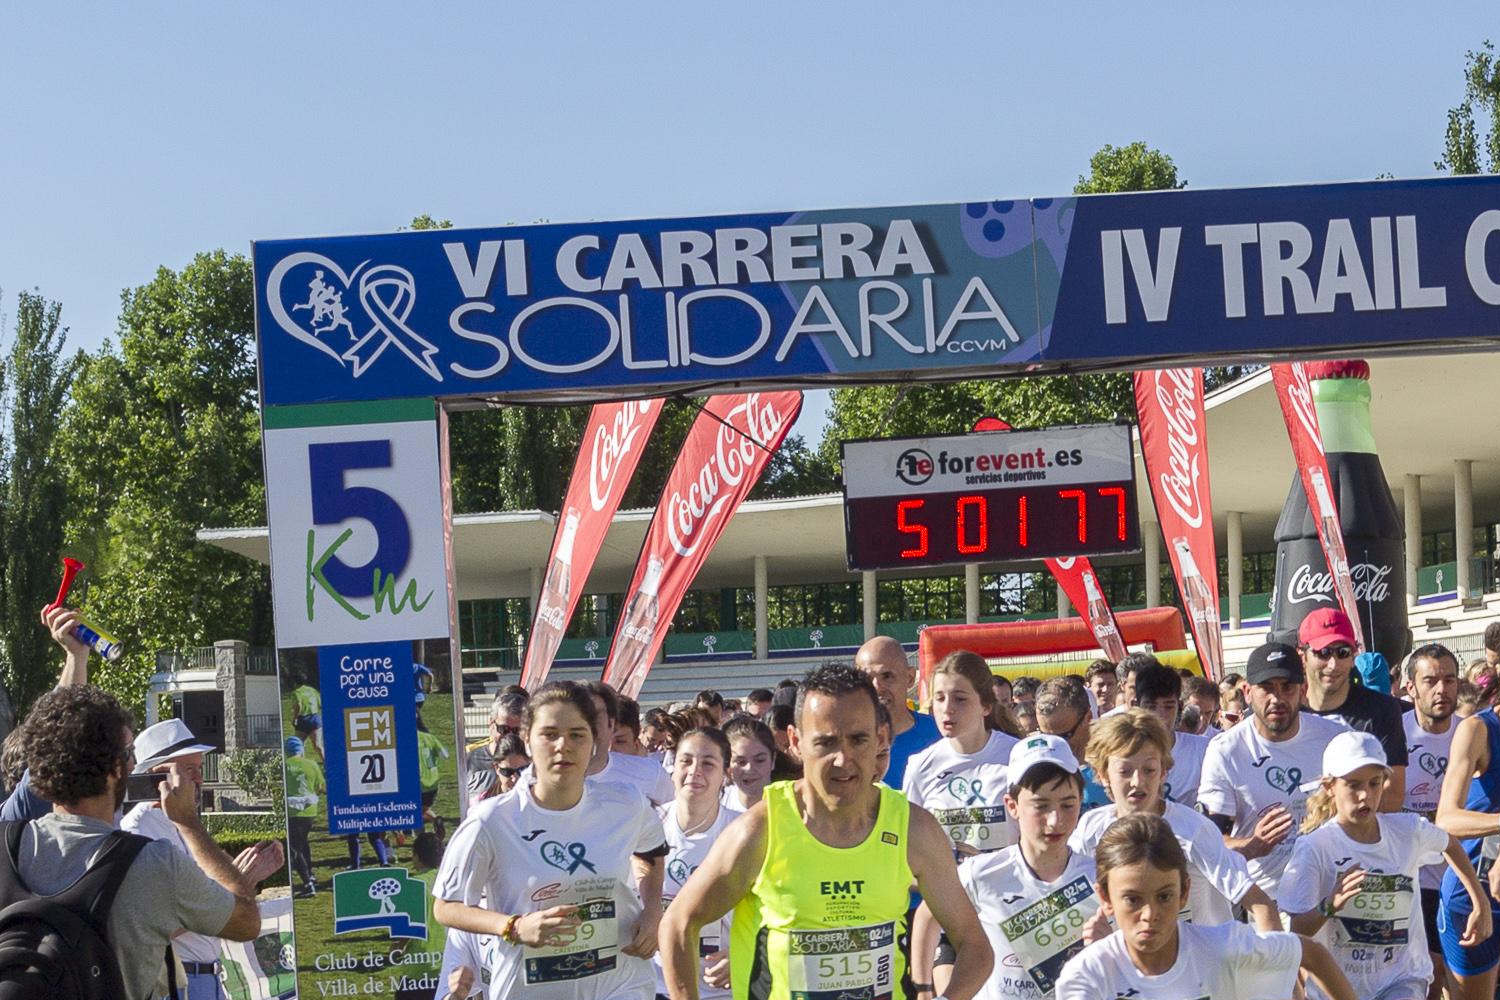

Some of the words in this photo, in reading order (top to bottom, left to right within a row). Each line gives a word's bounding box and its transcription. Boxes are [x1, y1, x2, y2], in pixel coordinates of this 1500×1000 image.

[443, 239, 527, 298] VI
[556, 219, 936, 291] CARRERA
[1100, 227, 1183, 325] IV
[1205, 214, 1447, 318] TRAIL
[449, 275, 1020, 380] SOLIDARIA
[947, 339, 1006, 353] CCVM
[938, 447, 1082, 475] forevent.es
[965, 472, 1002, 485] servicios
[1003, 470, 1046, 484] deportivos
[309, 439, 412, 599] 5
[304, 527, 435, 622] Km
[340, 655, 393, 672] Corre
[340, 673, 364, 689] por
[369, 671, 394, 684] una
[348, 685, 389, 699] causa
[333, 802, 377, 815] Fundación
[378, 801, 417, 813] Esclerosis
[337, 816, 372, 831] Múltiple
[373, 817, 383, 827] de
[384, 815, 414, 827] Madrid
[950, 825, 990, 841] 690
[820, 880, 865, 895] EMT
[1353, 894, 1396, 910] 653
[1034, 908, 1085, 947] 668
[804, 932, 850, 943] CARRERA
[315, 952, 357, 972] Club
[363, 951, 384, 969] de
[389, 950, 442, 970] Camp
[818, 953, 873, 978] 515
[877, 953, 890, 987] 0957
[316, 979, 359, 997] Villa
[364, 976, 385, 993] de
[390, 974, 440, 992] Madri
[817, 980, 843, 990] JUAN
[846, 977, 873, 987] PABLO
